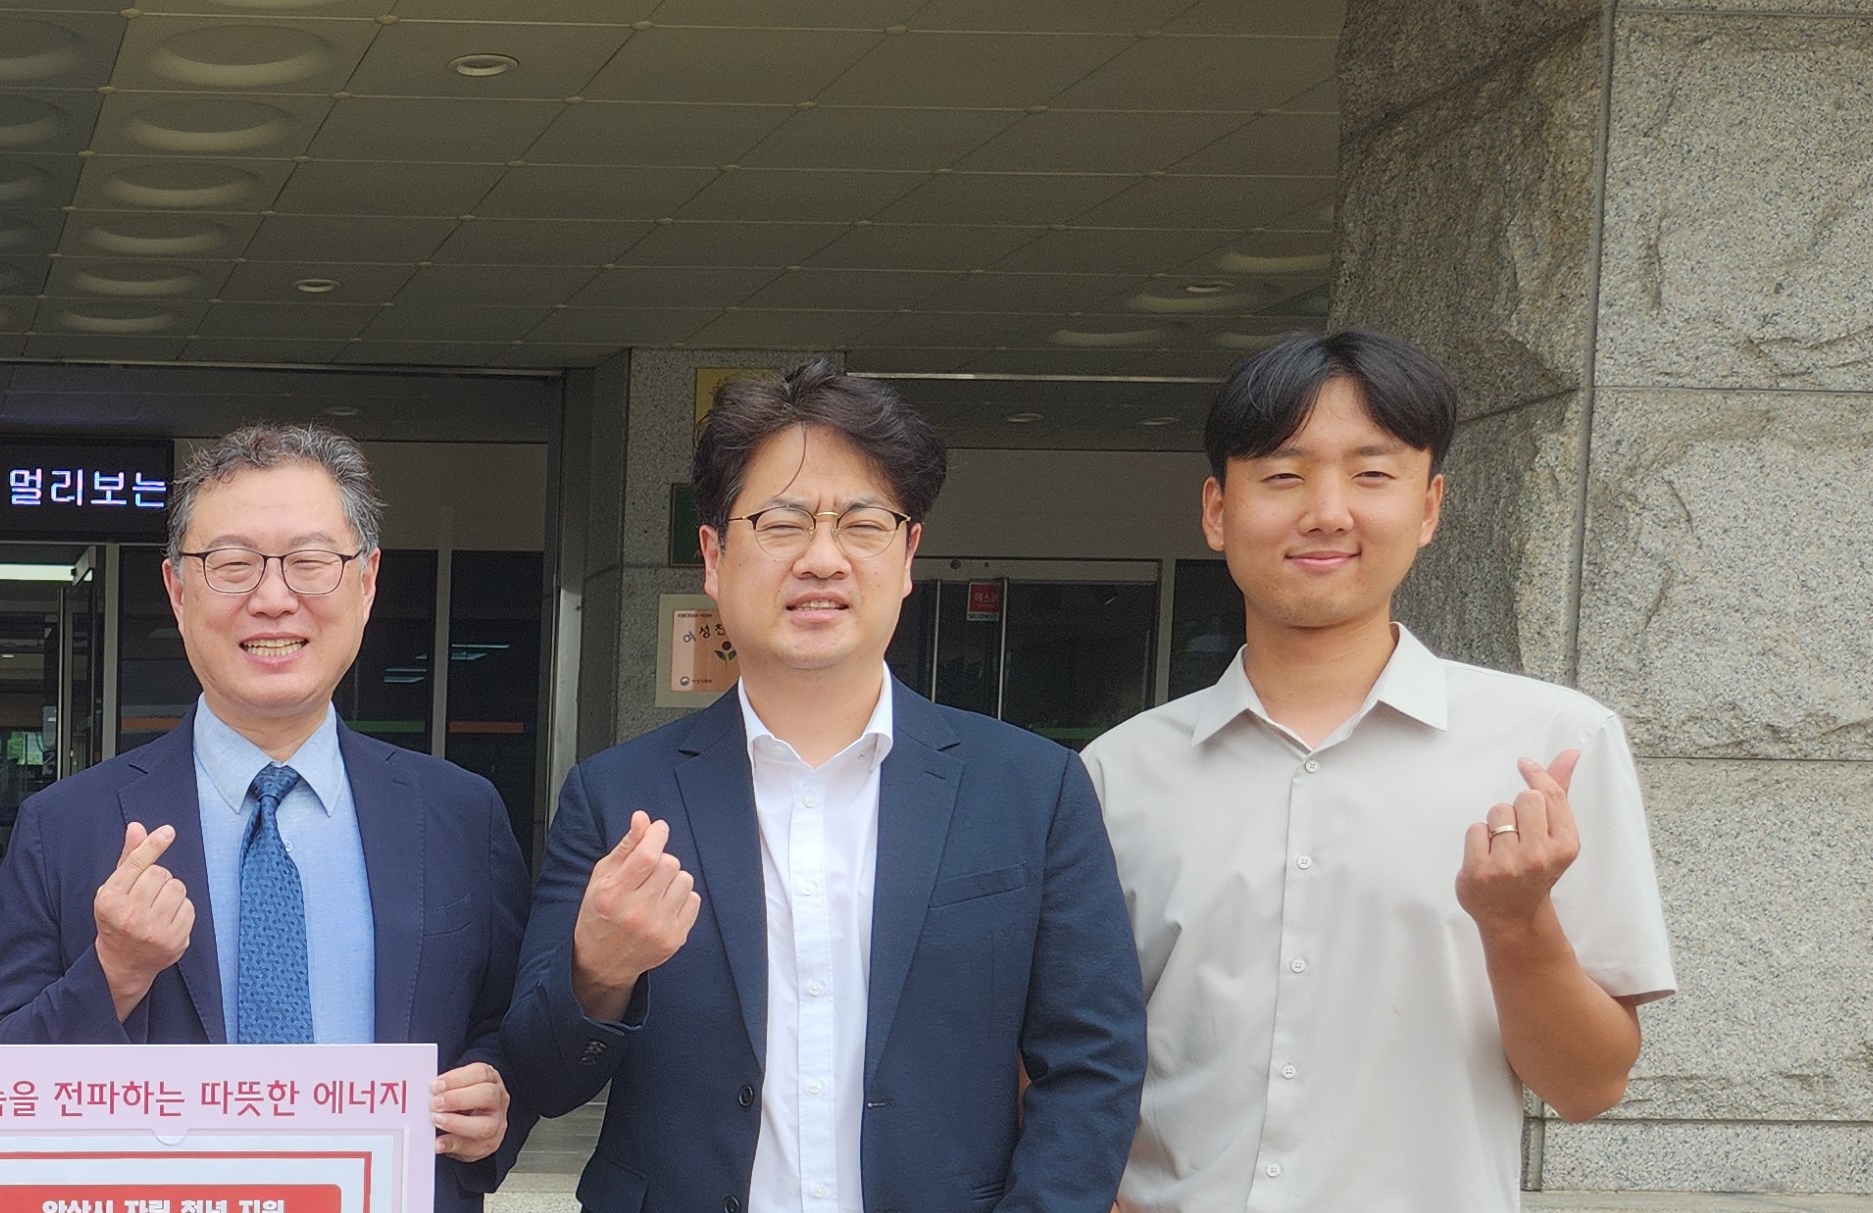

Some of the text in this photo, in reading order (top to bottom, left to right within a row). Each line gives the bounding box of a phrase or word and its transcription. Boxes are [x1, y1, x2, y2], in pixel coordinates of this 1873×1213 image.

[9, 468, 167, 508] 멀리보는
[53, 1080, 186, 1117] 전파하는
[200, 1080, 300, 1116] 따뜻한
[313, 1079, 407, 1114] 에너지
